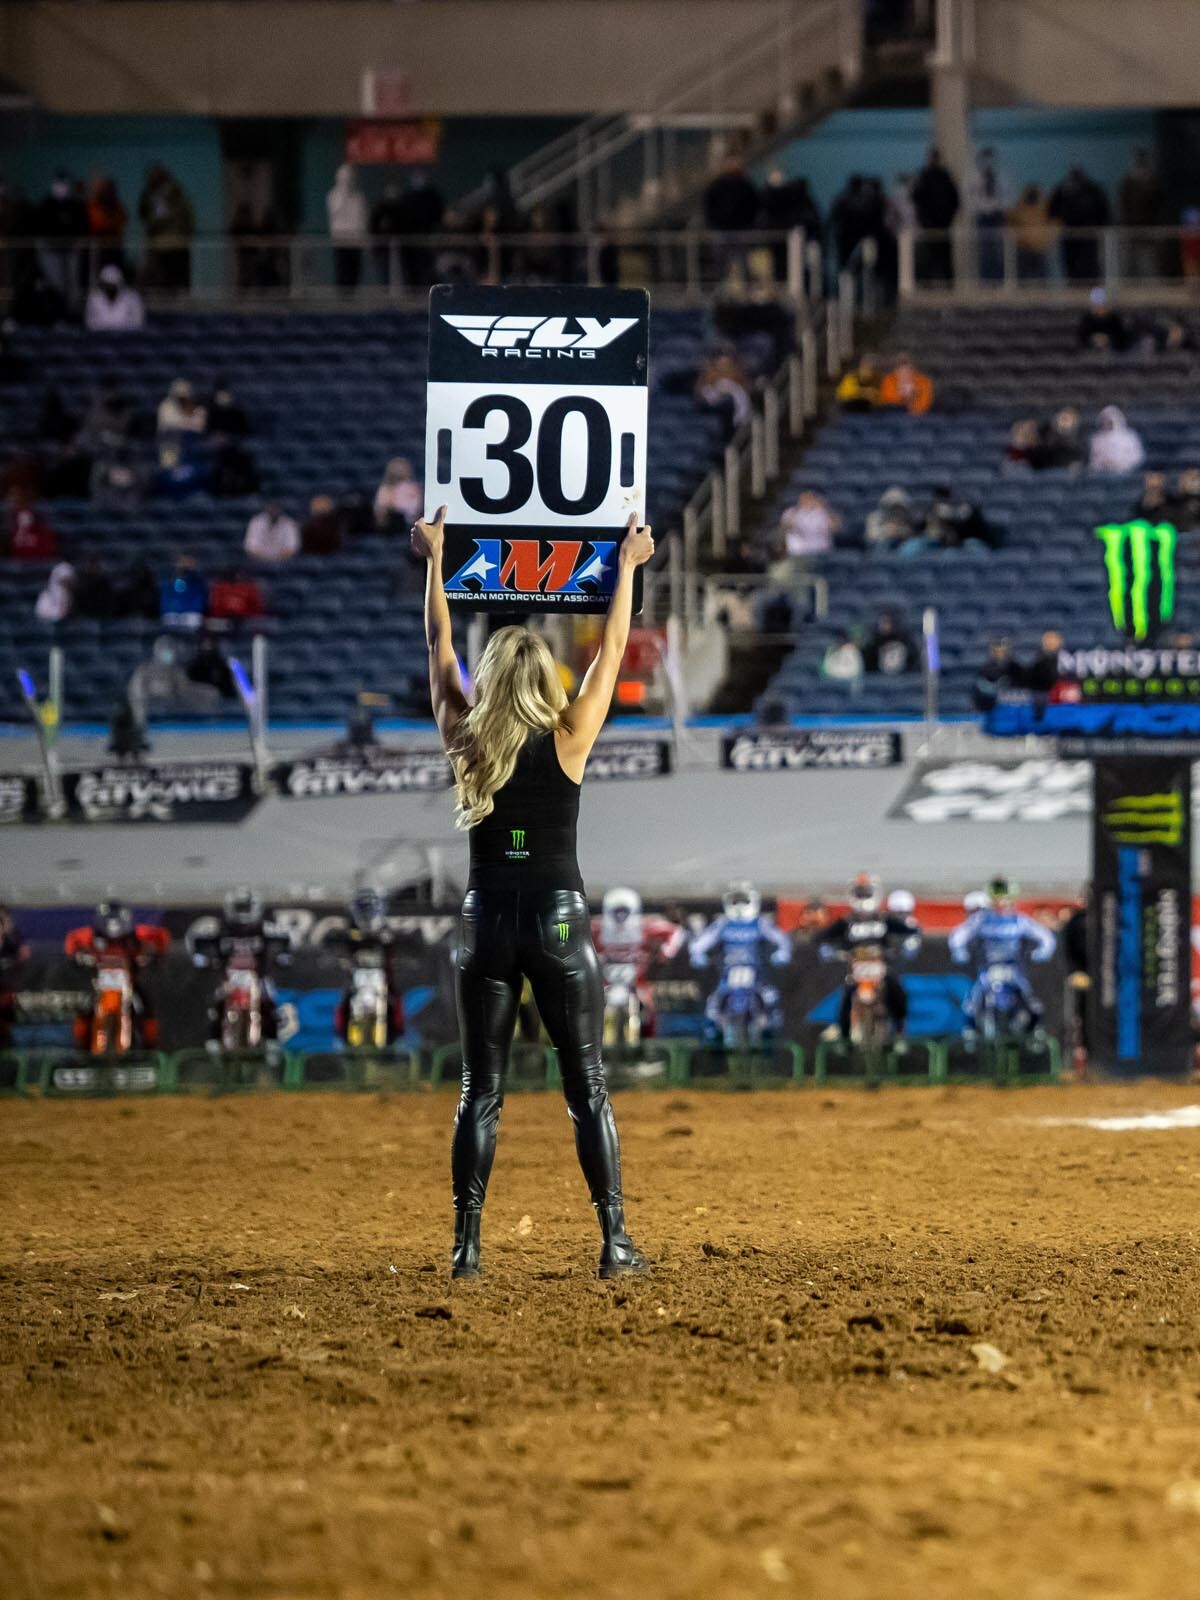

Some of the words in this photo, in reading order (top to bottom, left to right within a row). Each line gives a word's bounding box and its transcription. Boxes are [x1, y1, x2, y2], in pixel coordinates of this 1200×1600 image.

[440, 314, 640, 348] FLY
[482, 347, 597, 360] RACING
[459, 394, 612, 516] 30
[444, 538, 618, 593] AMA
[444, 592, 488, 601] MERICAN
[488, 592, 561, 602] MOTORCYCLIST
